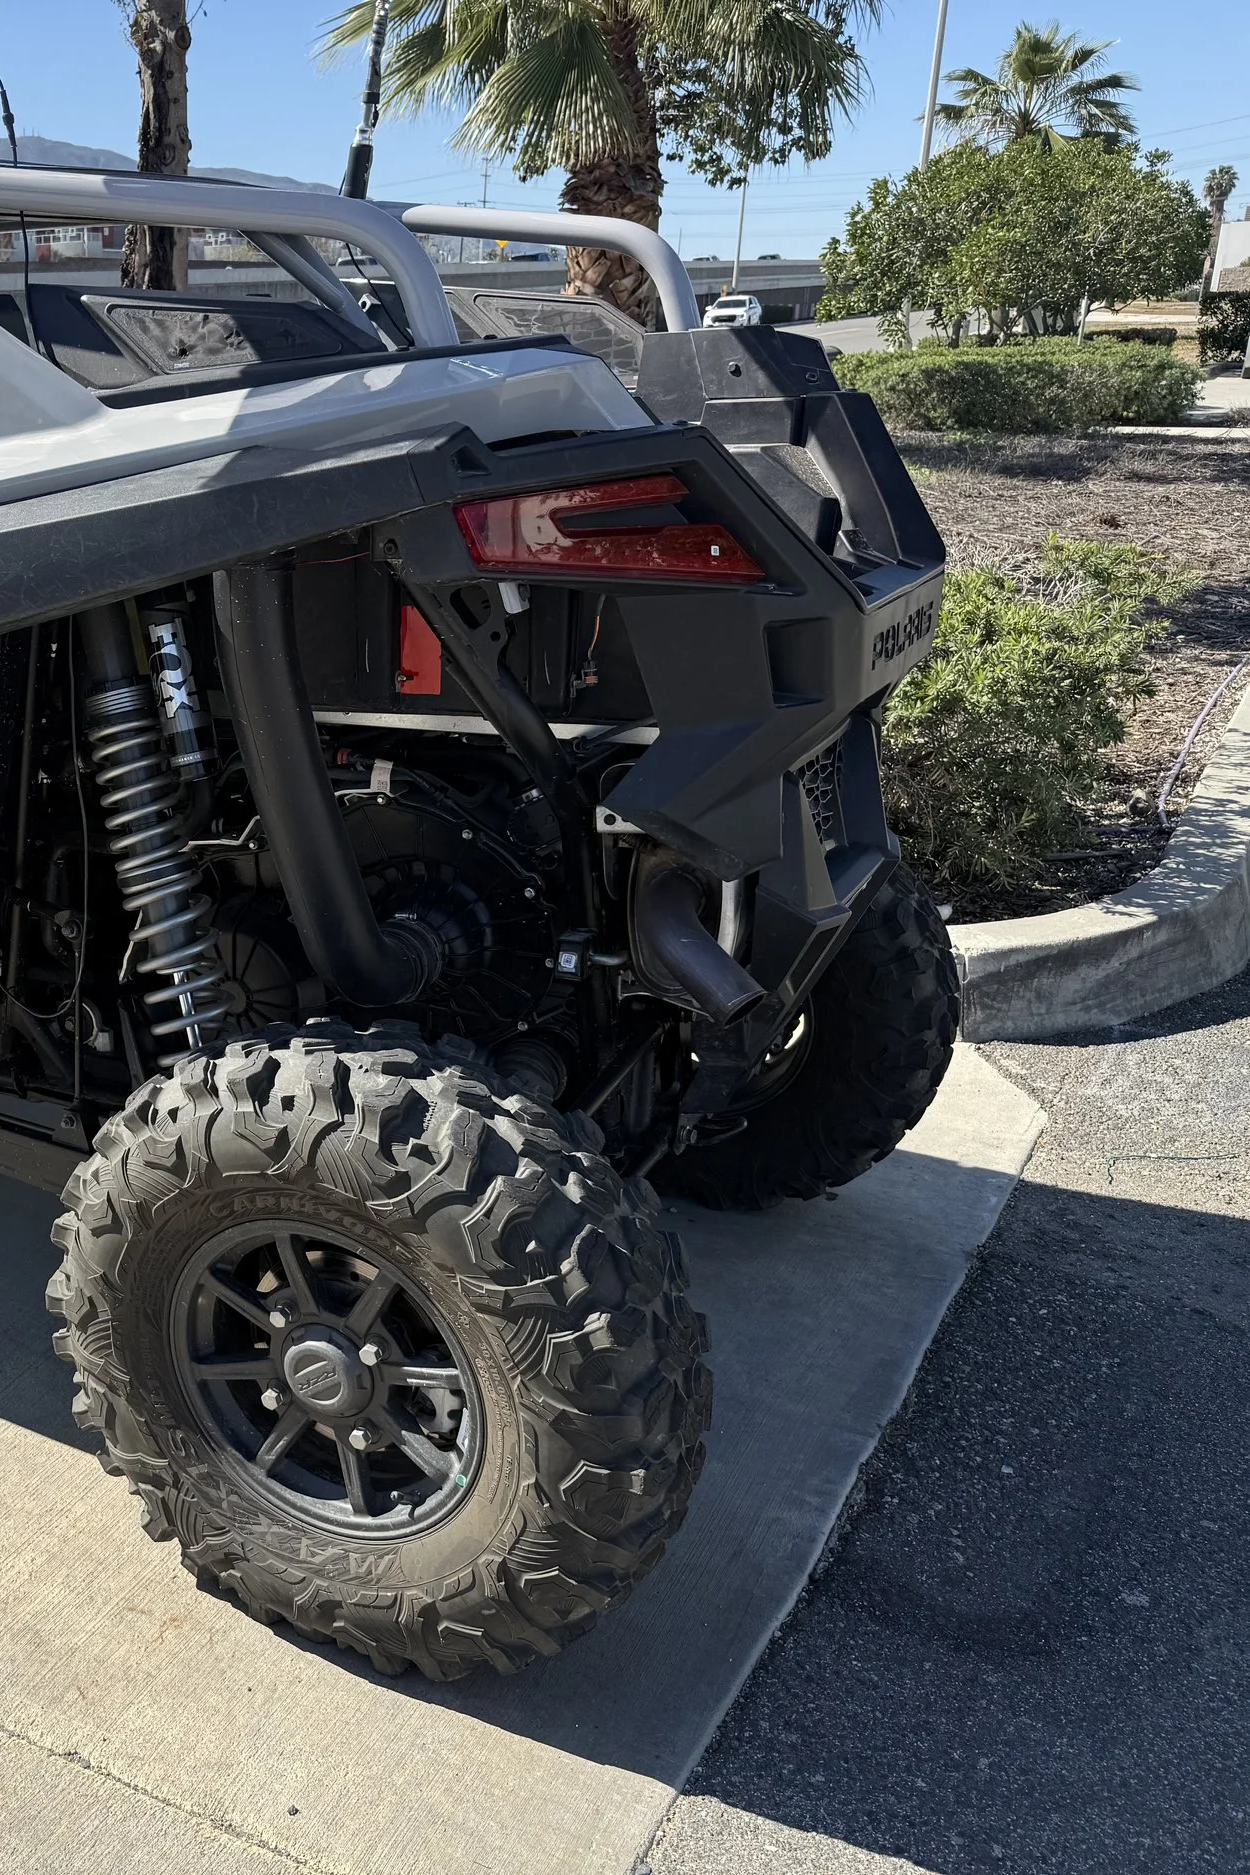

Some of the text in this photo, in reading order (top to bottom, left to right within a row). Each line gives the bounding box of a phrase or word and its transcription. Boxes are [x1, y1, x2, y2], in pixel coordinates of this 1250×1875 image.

[148, 617, 200, 719] FOX
[871, 600, 934, 671] POLARIS
[166, 1426, 404, 1583] MAXXIS
